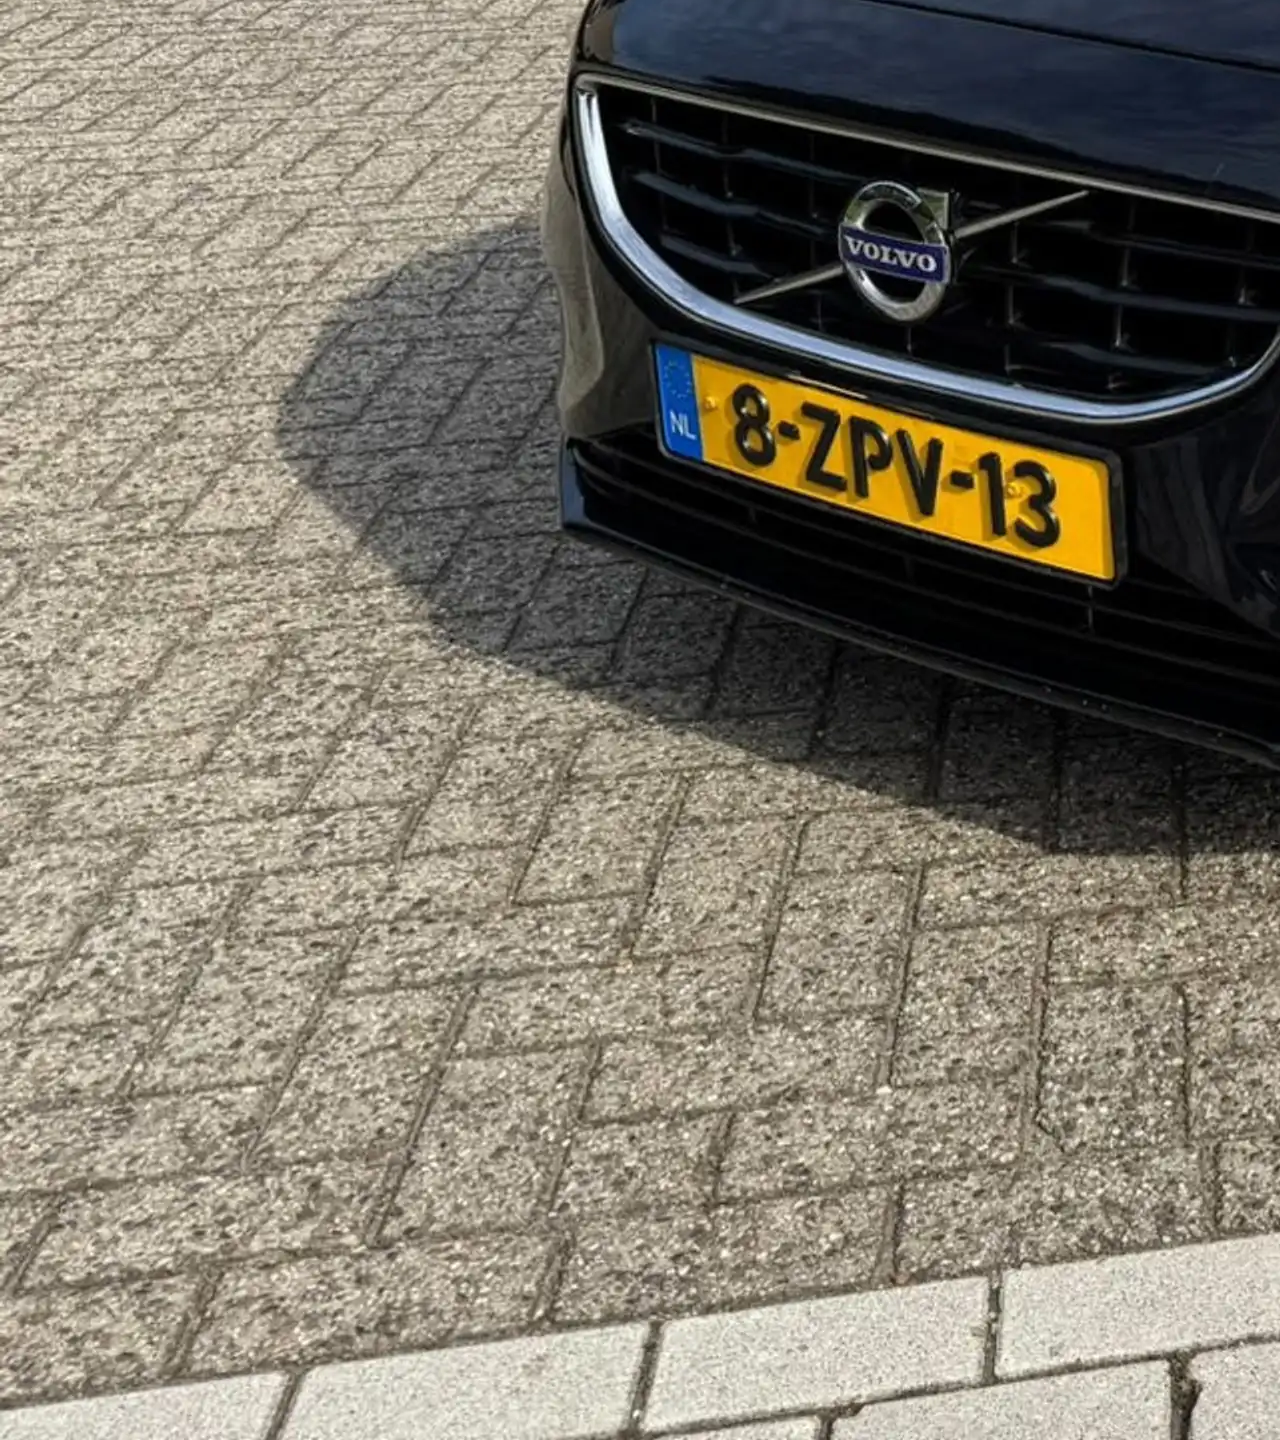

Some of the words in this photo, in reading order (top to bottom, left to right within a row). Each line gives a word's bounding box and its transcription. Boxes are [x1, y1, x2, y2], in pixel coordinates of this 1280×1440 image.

[843, 234, 938, 273] VOLVO
[669, 408, 698, 441] NL
[730, 384, 1061, 550] 8-ZPV-13
